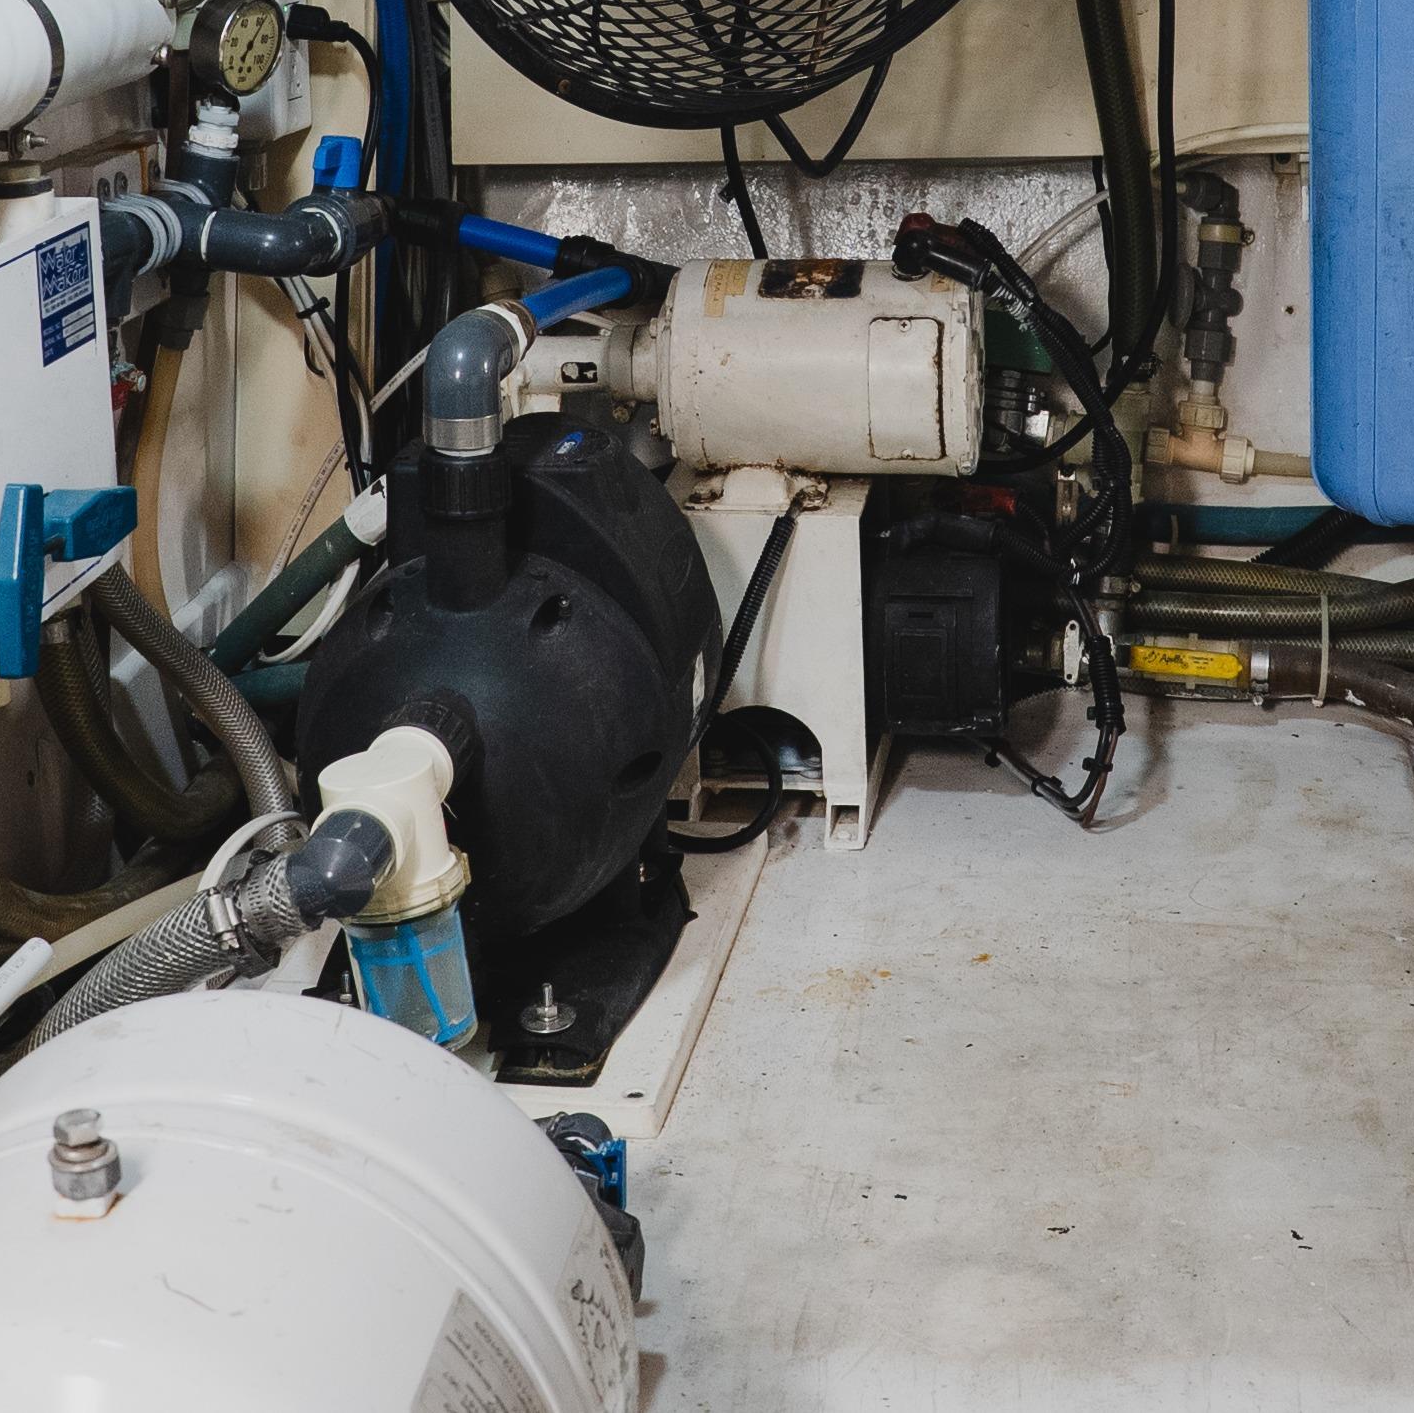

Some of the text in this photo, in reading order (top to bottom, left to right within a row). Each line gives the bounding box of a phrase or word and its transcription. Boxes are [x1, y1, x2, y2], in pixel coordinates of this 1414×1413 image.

[241, 19, 249, 28] 40
[231, 37, 239, 47] 20
[261, 34, 269, 44] 80
[253, 54, 265, 65] 100
